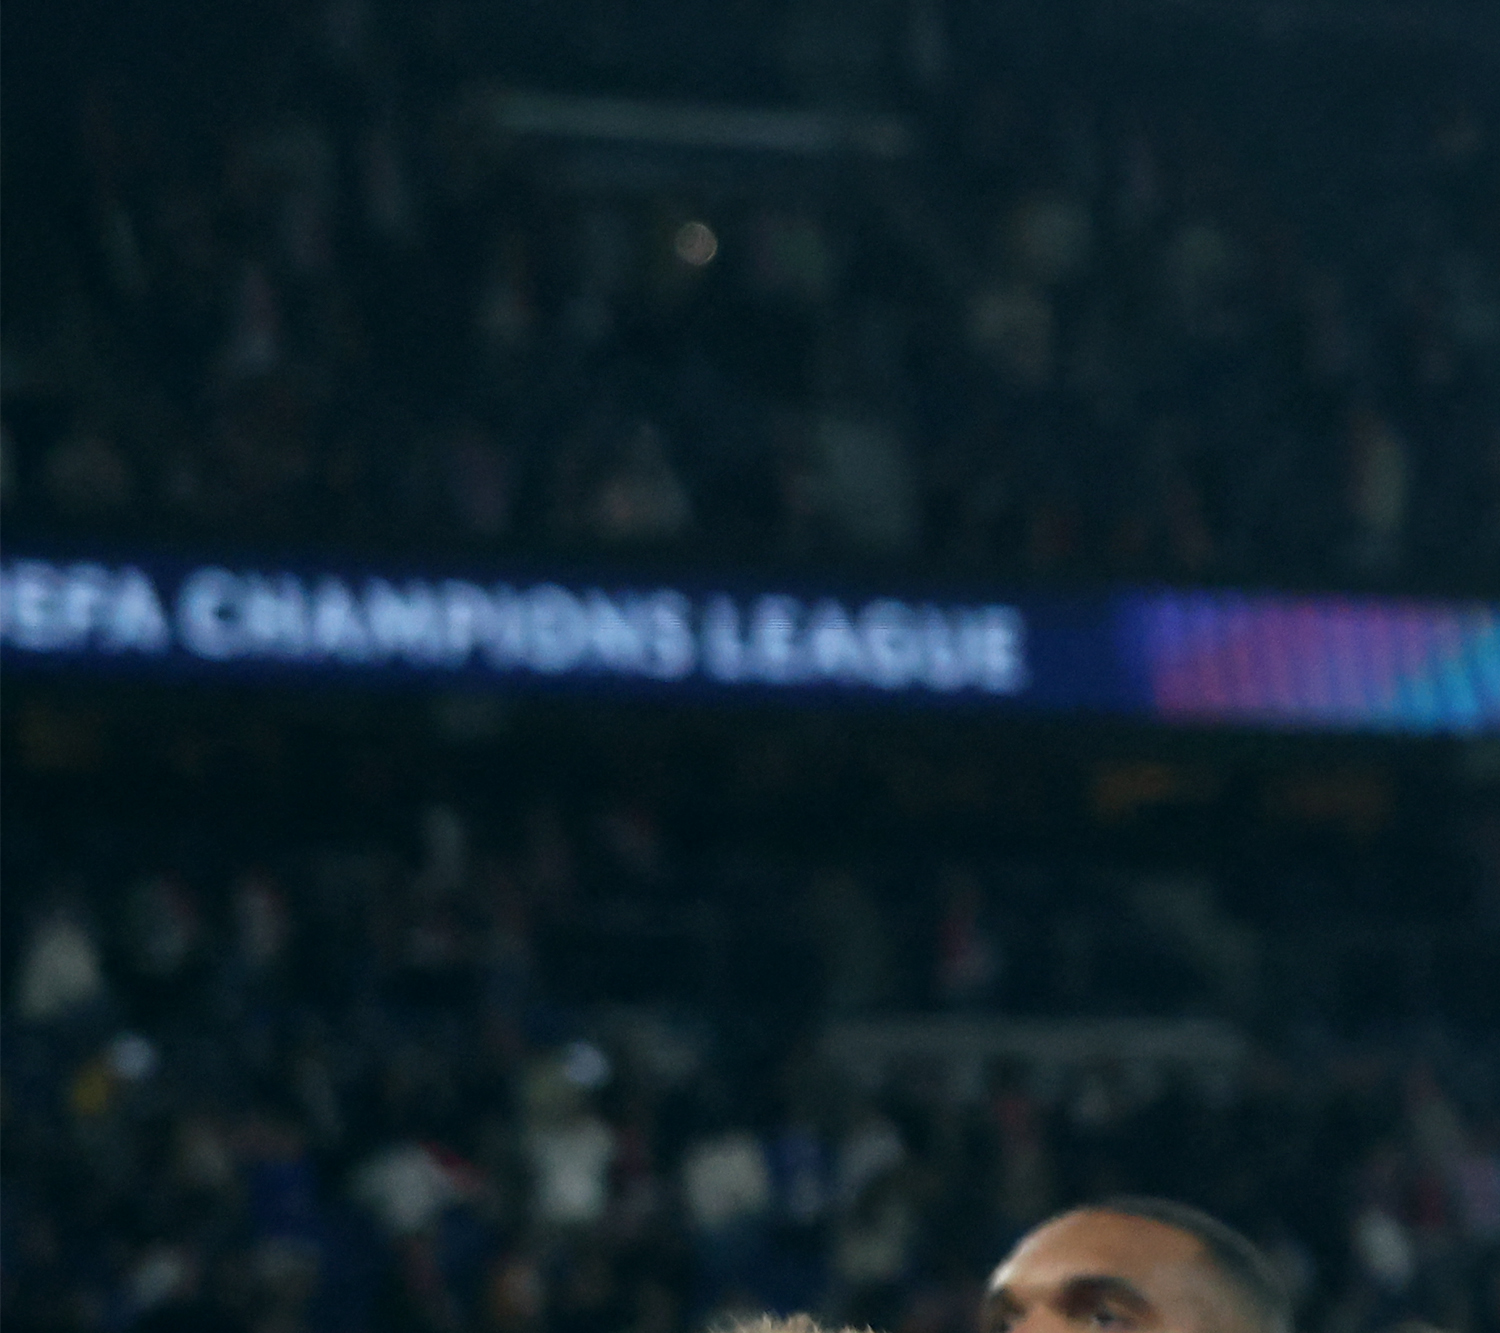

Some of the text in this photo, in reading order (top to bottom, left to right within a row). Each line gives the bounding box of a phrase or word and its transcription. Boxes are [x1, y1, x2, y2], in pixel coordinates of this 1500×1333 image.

[0, 557, 1030, 696] EFA CHAMPIONS LEAGUE
